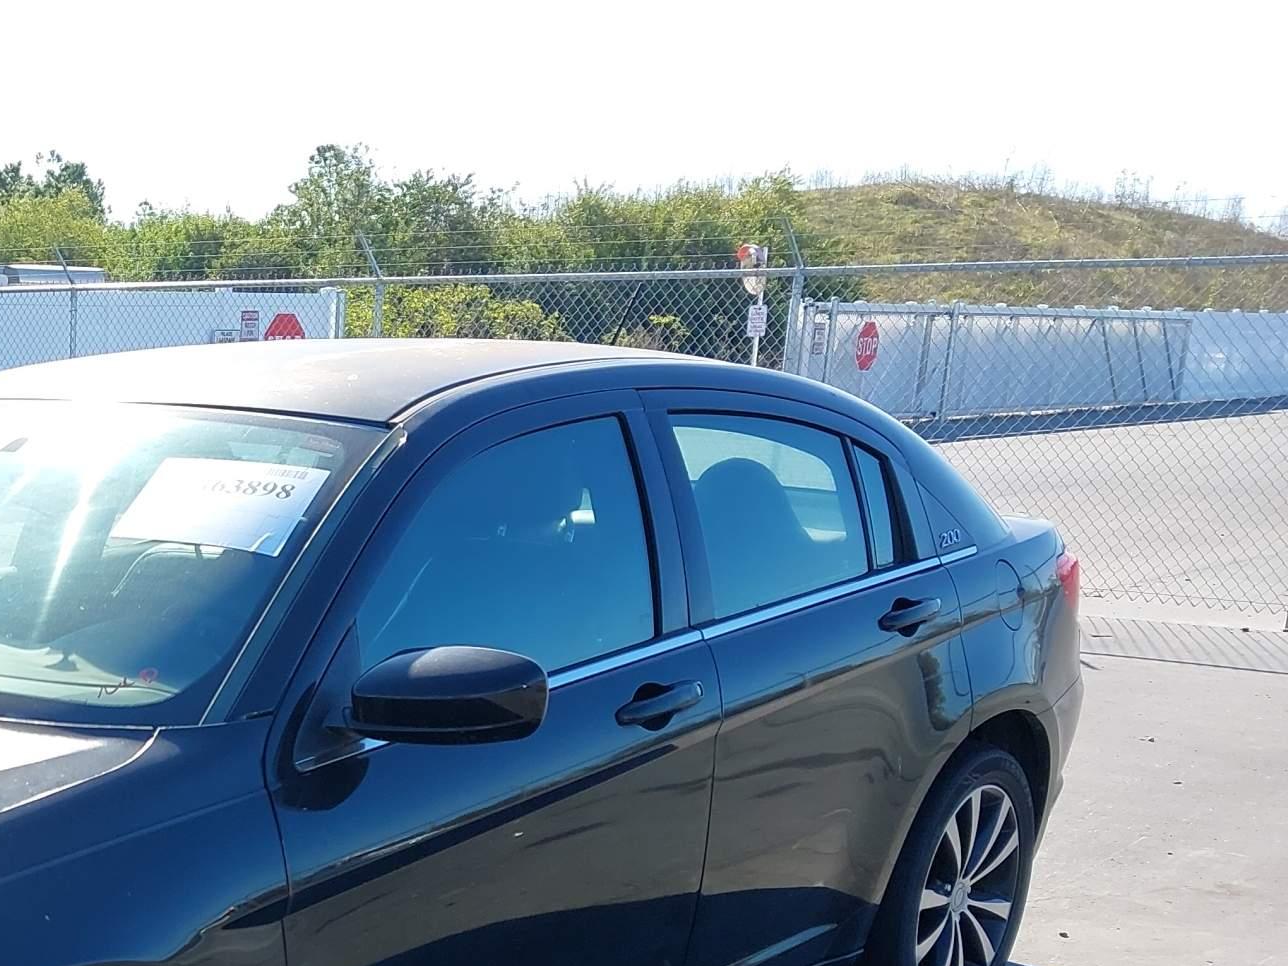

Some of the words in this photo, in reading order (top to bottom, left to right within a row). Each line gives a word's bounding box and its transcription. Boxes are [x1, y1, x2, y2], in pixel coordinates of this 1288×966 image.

[857, 337, 878, 356] STOP
[201, 478, 296, 500] 63898
[939, 528, 961, 549] 200
